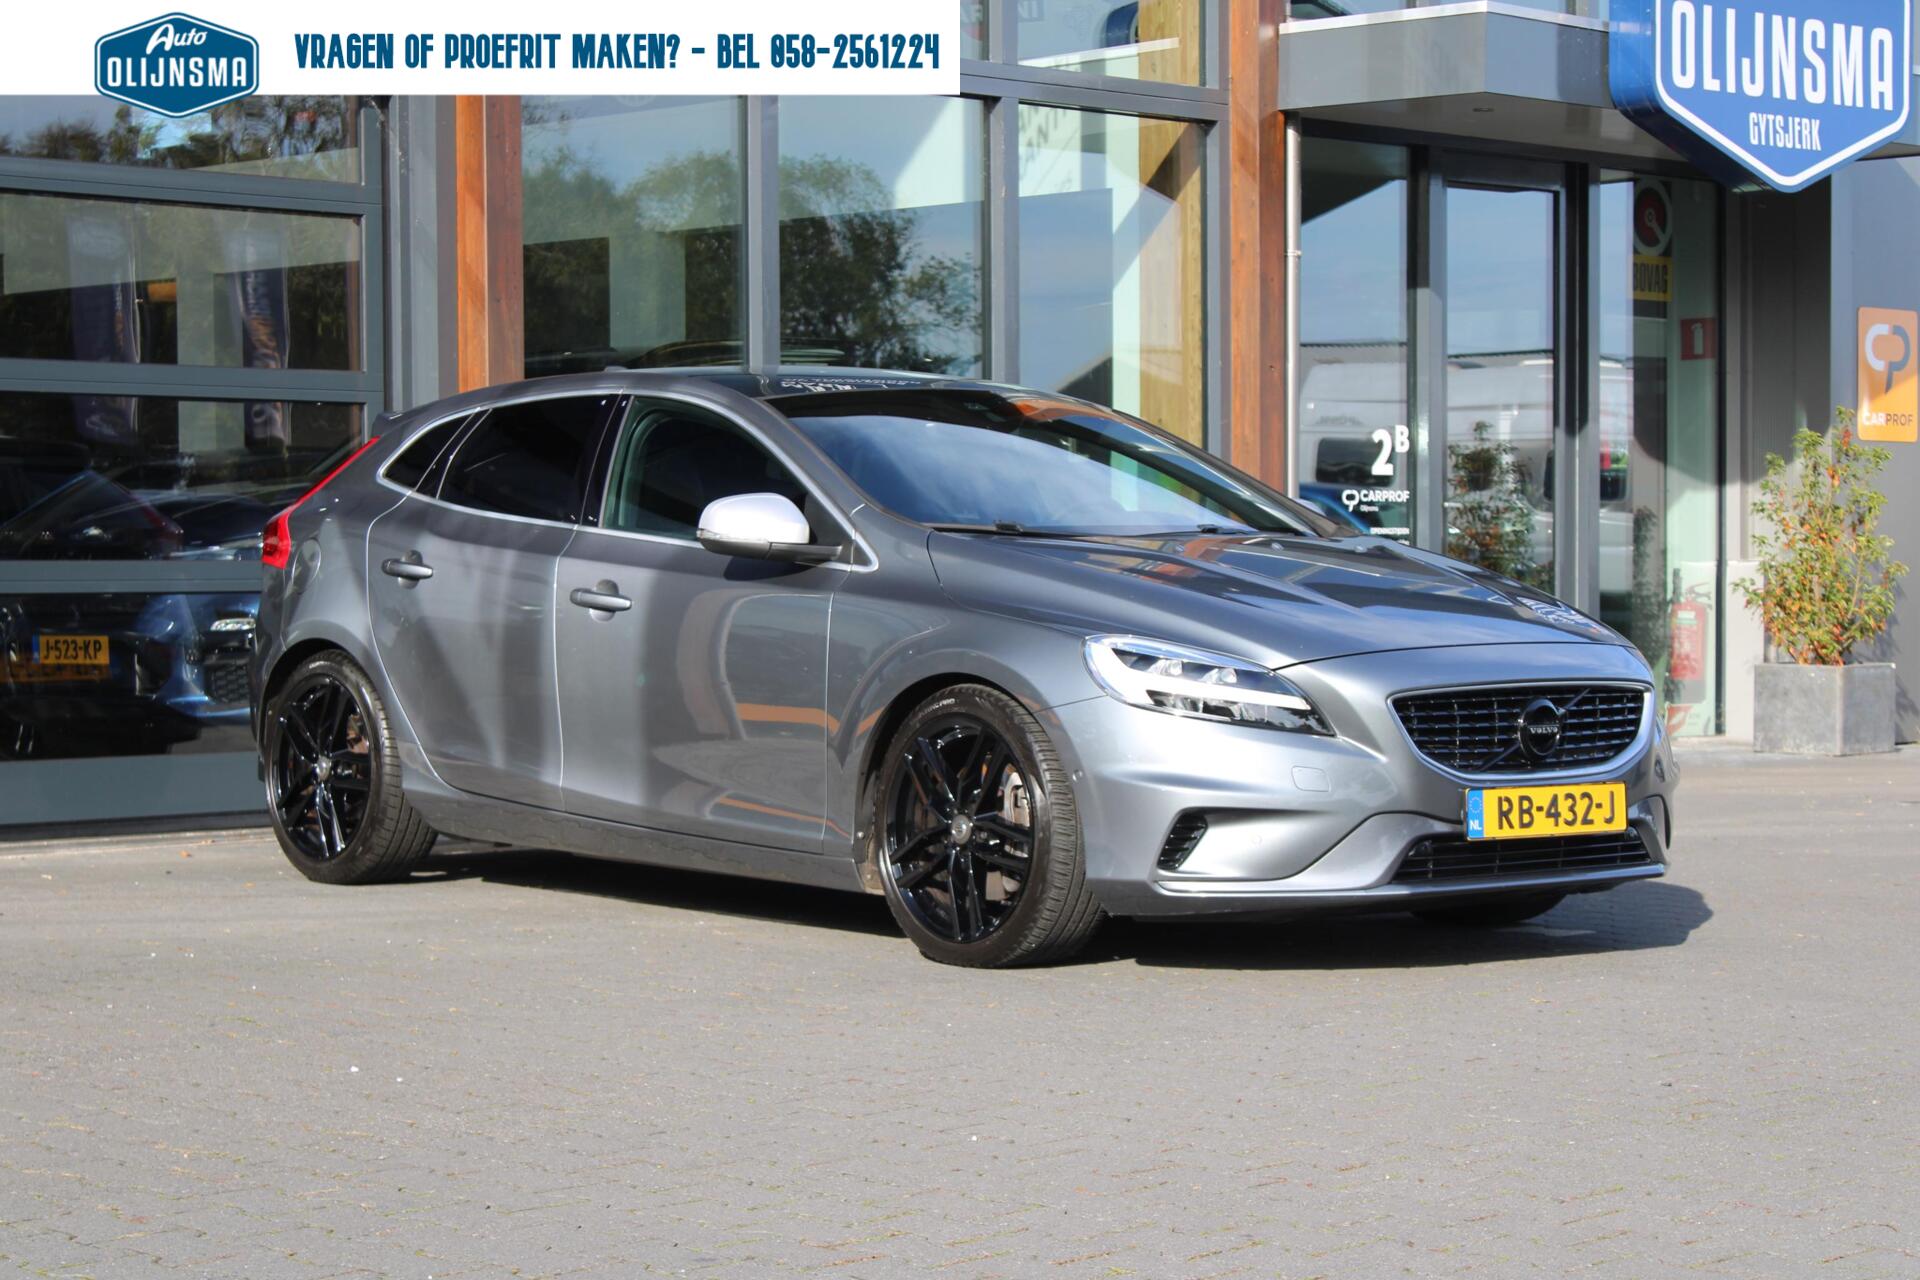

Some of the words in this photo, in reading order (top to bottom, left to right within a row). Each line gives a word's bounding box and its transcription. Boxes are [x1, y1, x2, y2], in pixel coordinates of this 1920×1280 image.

[1671, 0, 1894, 111] OLIJNSMA
[1749, 112, 1822, 151] GYTSJERK
[1862, 412, 1913, 426] CARPROF
[1360, 489, 1410, 502] CARPROF
[43, 638, 103, 660] J-523-KP
[1530, 726, 1558, 734] VOLVO
[1497, 790, 1615, 830] RB-432-J
[1469, 818, 1482, 831] NL
